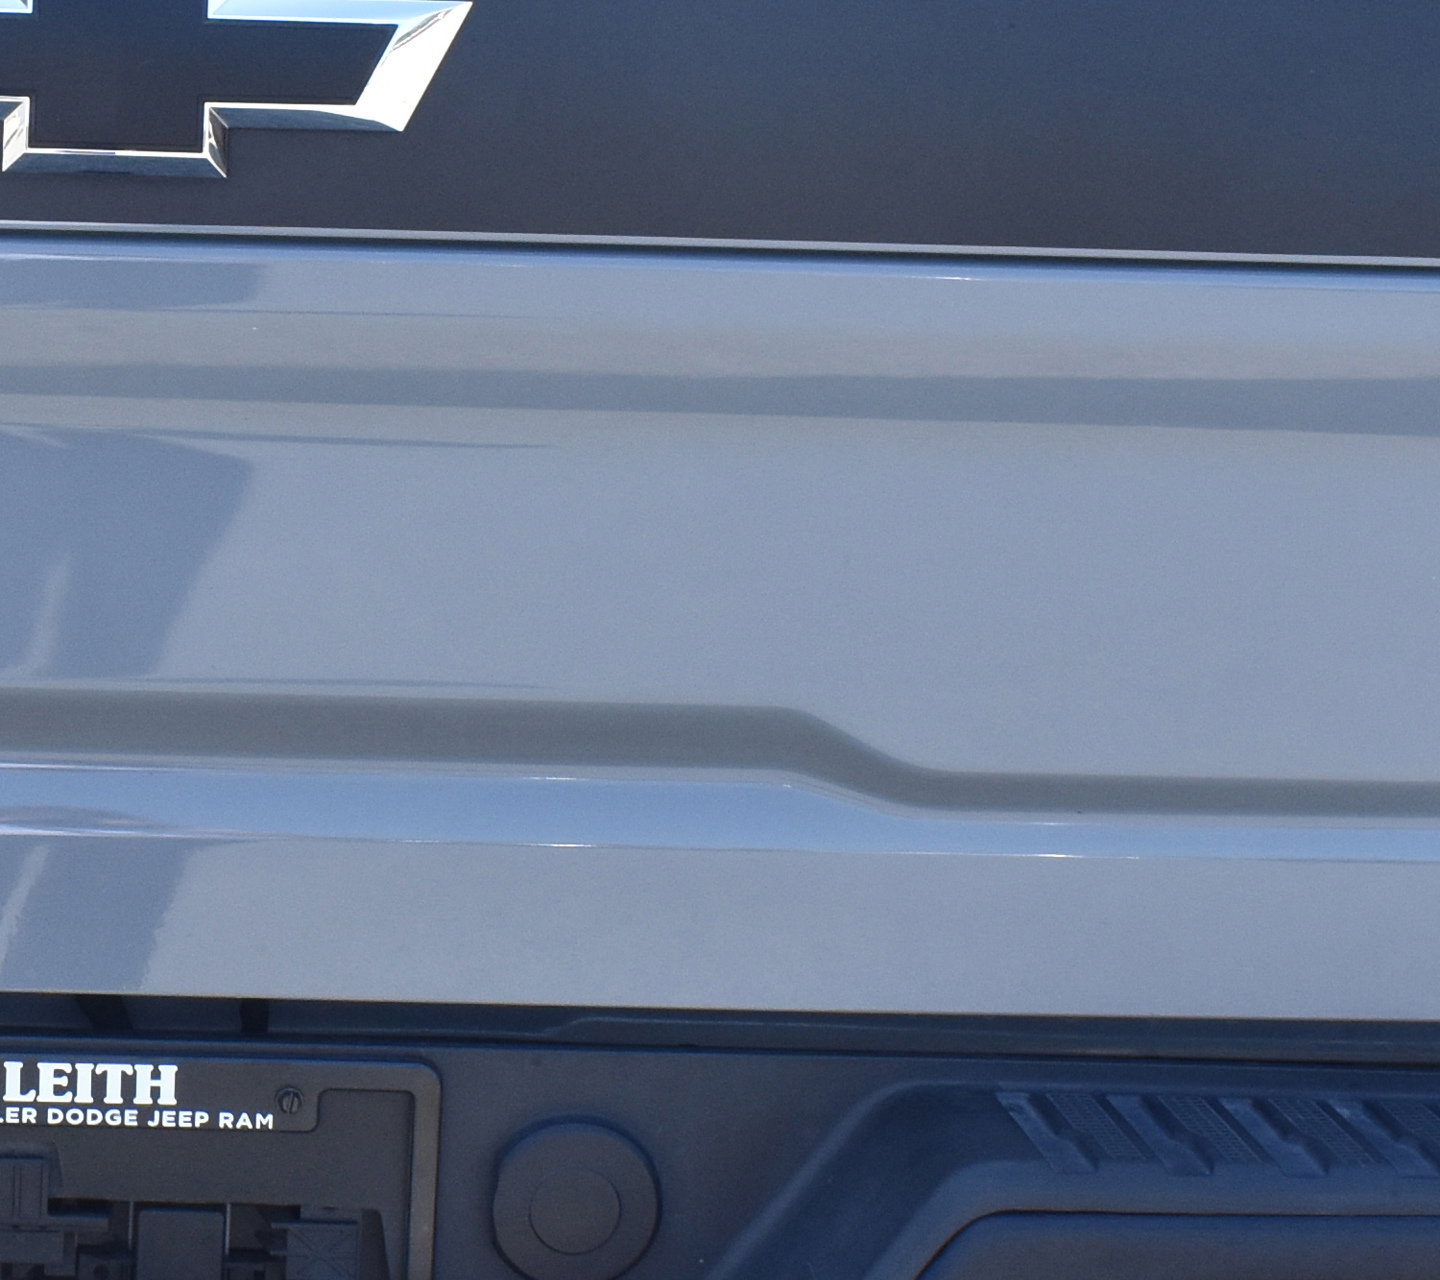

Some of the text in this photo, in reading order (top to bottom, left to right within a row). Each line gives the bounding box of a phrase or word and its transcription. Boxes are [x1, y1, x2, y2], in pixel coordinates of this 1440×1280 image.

[2, 1060, 179, 1106] LEITH
[47, 1107, 139, 1127] DODGE
[147, 1110, 210, 1128] JEEP
[218, 1112, 274, 1130] RAM
